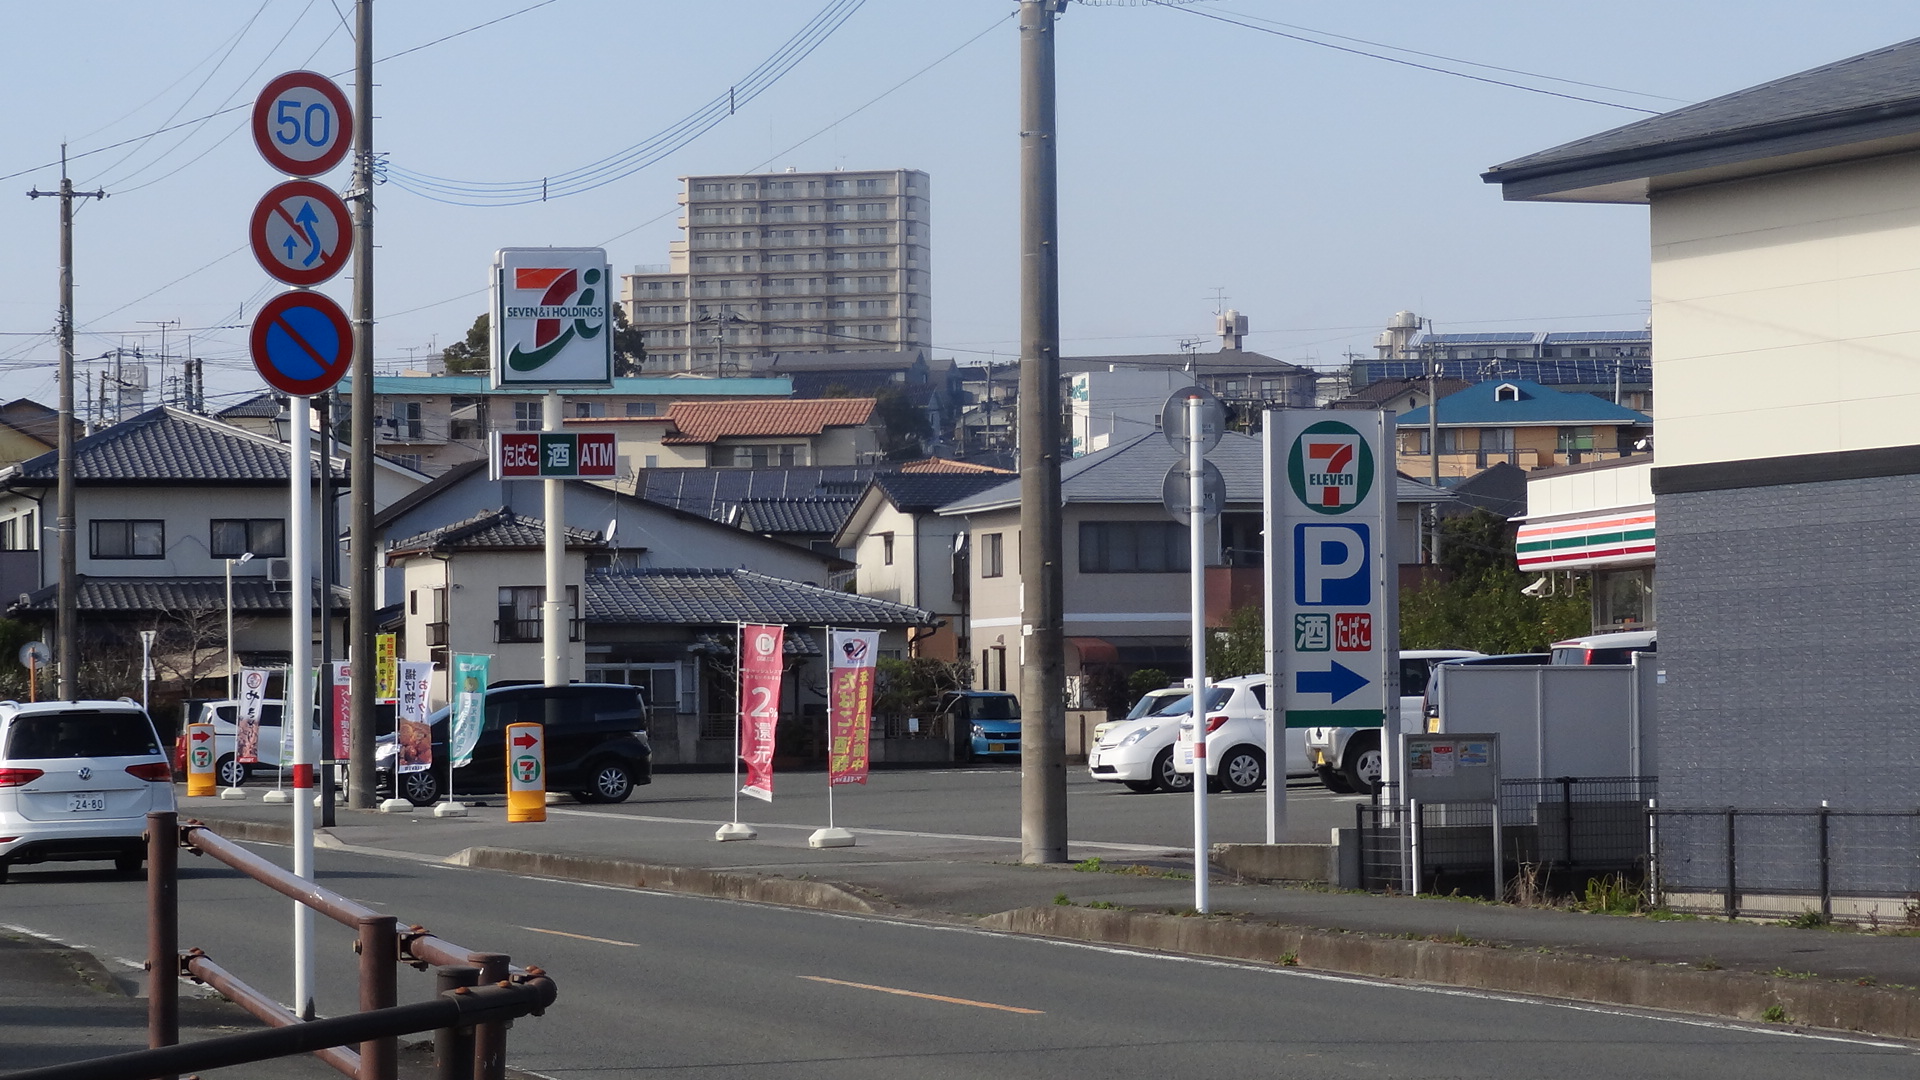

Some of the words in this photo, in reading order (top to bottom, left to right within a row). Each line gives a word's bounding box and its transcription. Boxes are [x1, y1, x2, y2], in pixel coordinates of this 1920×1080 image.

[276, 100, 331, 147] 50
[508, 306, 550, 318] SEVEN&i
[552, 306, 604, 318] HOLDINGS
[503, 442, 539, 467] たばこ
[547, 442, 571, 468] 酒
[580, 442, 614, 467] ATM
[1304, 526, 1365, 603] P
[1296, 616, 1328, 649] 酒
[1337, 616, 1372, 648] たばこ
[753, 722, 772, 764] 還元
[75, 799, 103, 810] 24-80
